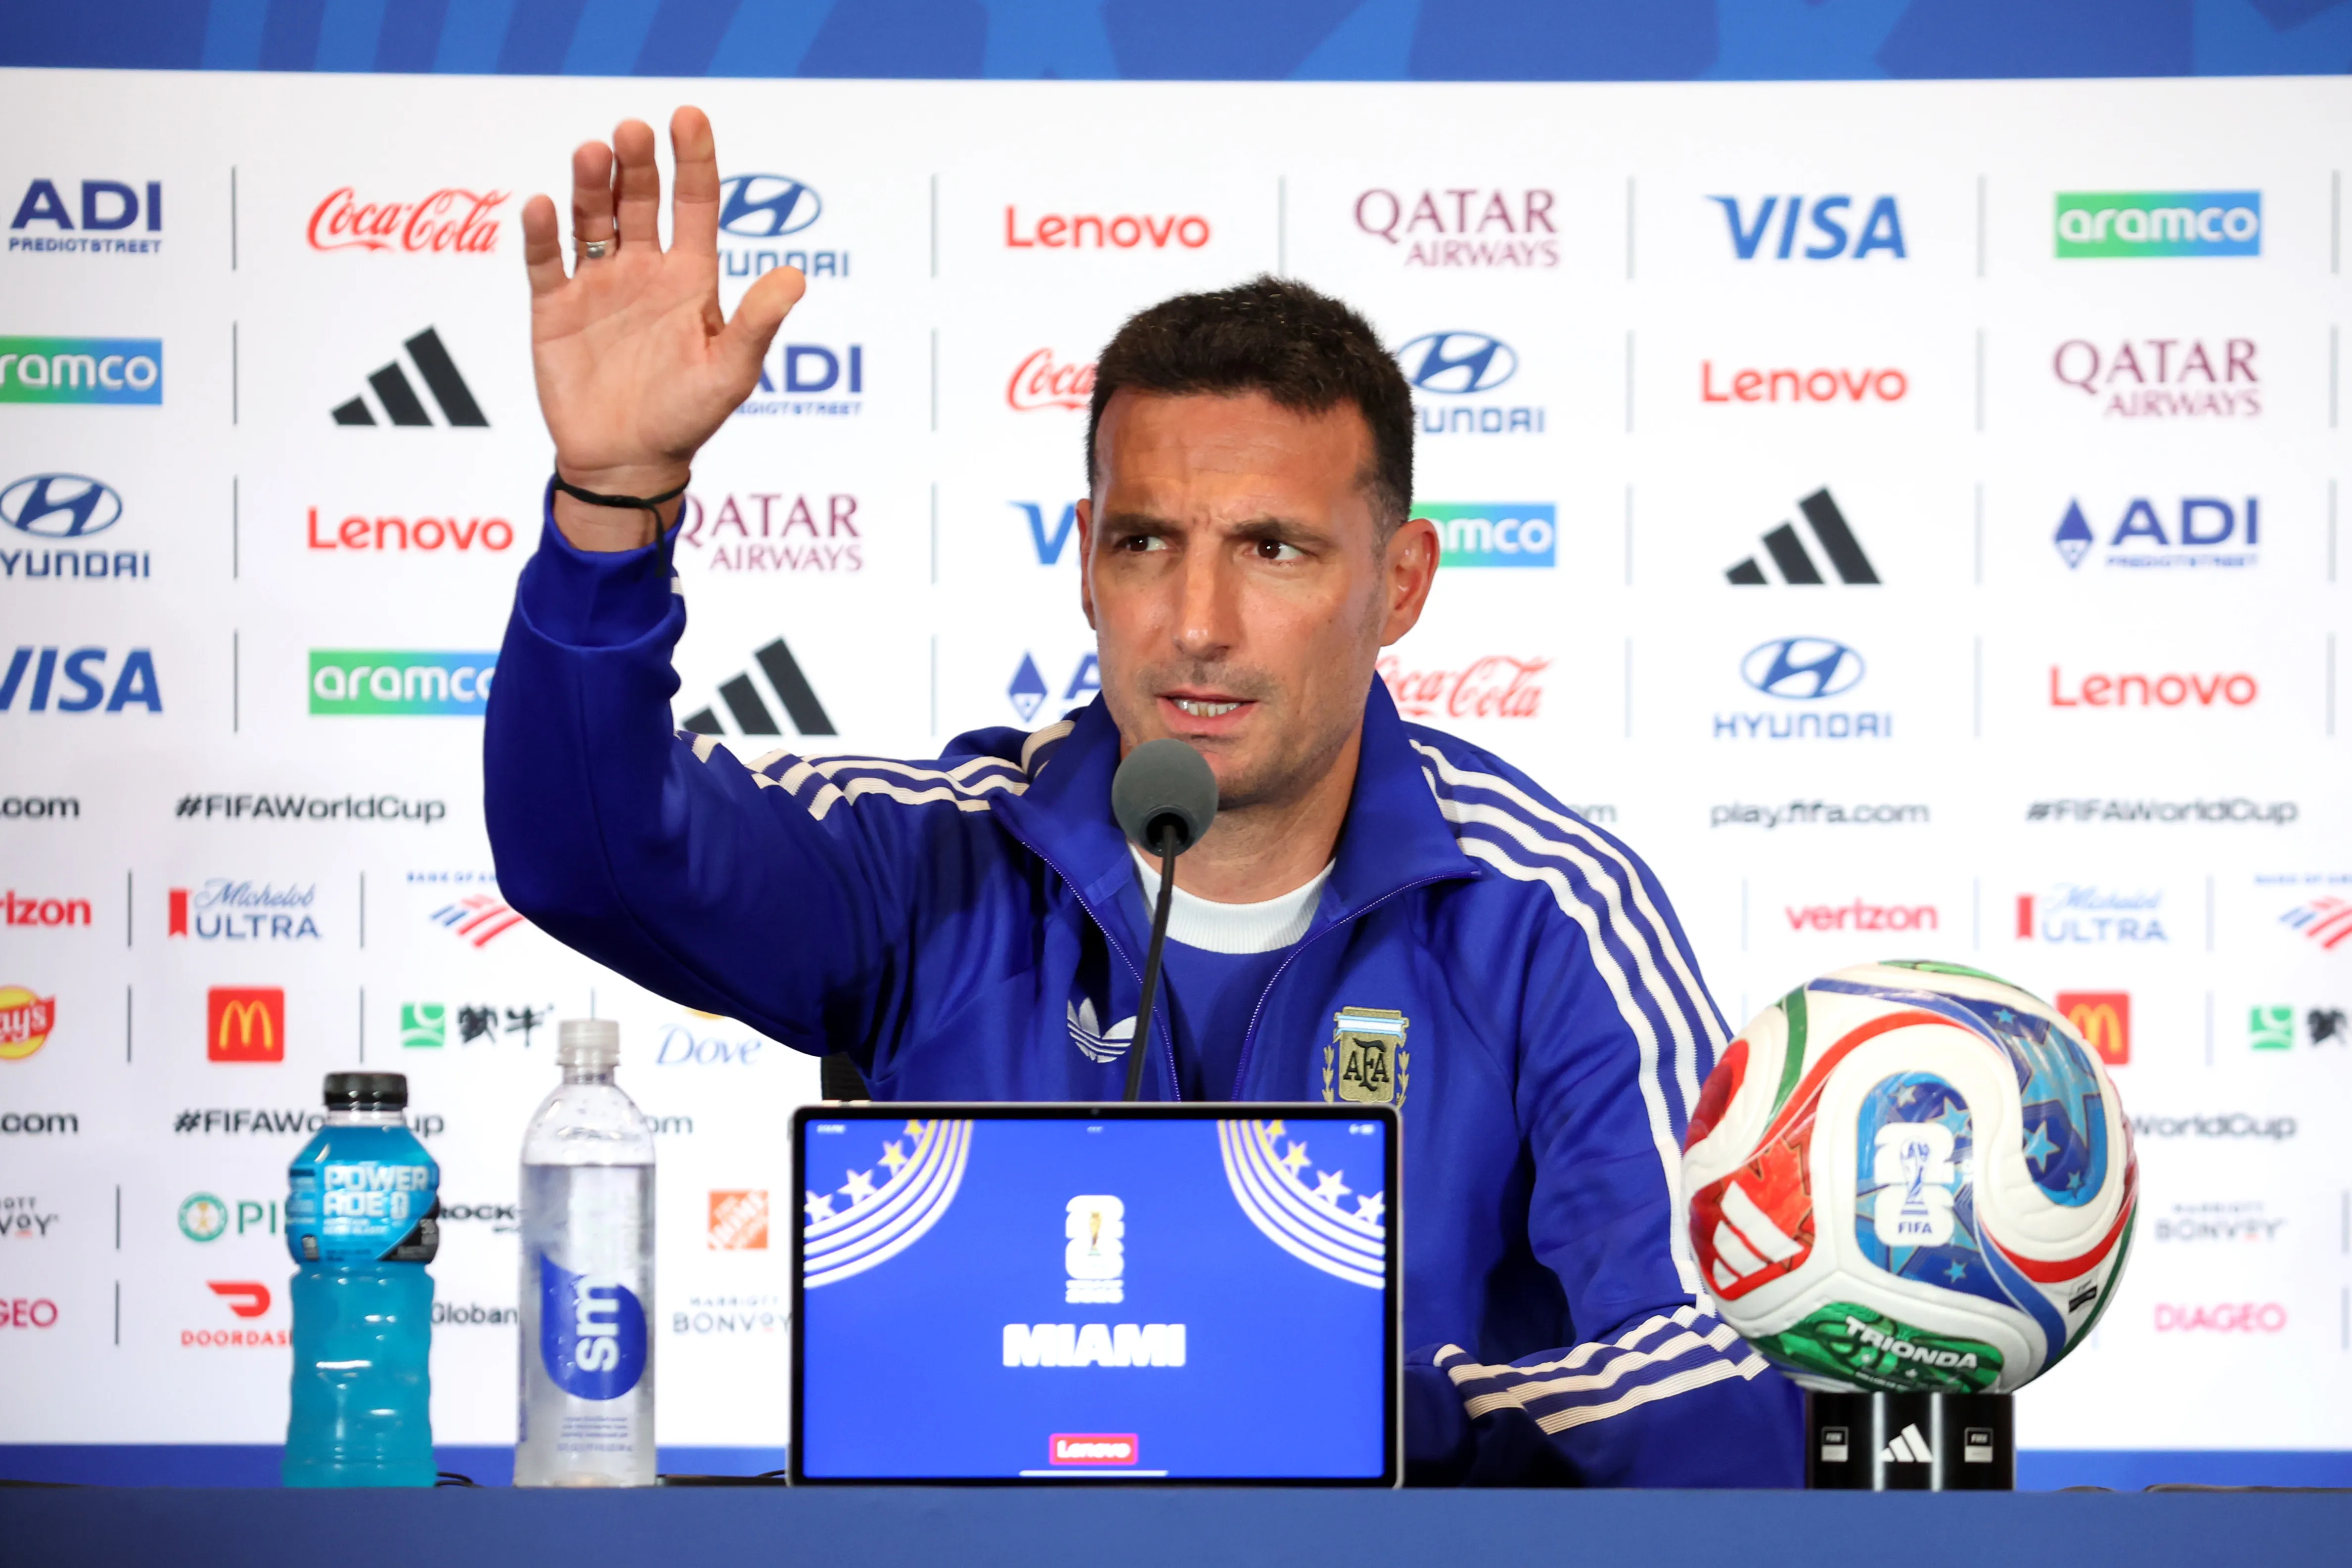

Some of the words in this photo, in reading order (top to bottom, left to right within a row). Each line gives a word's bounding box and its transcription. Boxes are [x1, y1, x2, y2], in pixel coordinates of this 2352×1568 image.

[10, 179, 161, 231] ADI
[307, 187, 511, 253] Coca-Cola
[1354, 189, 1558, 244] QATAR
[1006, 206, 1210, 249] Lenovo
[1704, 195, 1907, 260] VISA
[2059, 207, 2258, 242] aramco
[8, 238, 162, 253] PREDICTSTREET
[1404, 240, 1560, 268] AIRWAYS
[719, 251, 849, 276] UNDAI
[0, 353, 158, 389] ramco
[1702, 361, 1908, 403] Lenovo
[2053, 339, 2259, 394] QATAR
[2108, 389, 2262, 417] AIRWAYS
[1421, 406, 1544, 434] UNDAI
[308, 507, 513, 551] Lenovo
[2109, 496, 2259, 546] ADI
[0, 549, 149, 578] YUNDAI
[710, 544, 862, 571] AIRWAYS
[2050, 666, 2258, 707] Lenovo
[1714, 713, 1891, 739] HYUNDAI
[175, 794, 446, 825] #FIFAWorldCup
[1711, 800, 1929, 829] play.fifa.com
[2026, 798, 2298, 826] #FIFAWorldCup
[196, 878, 316, 909] Michelob
[197, 915, 320, 940] ULTRA
[1786, 898, 1938, 931] verizon
[2043, 917, 2168, 943] ULTRA
[656, 1024, 762, 1066] Dove
[1343, 1037, 1389, 1092] AFA
[324, 1165, 429, 1191] POWER
[323, 1190, 384, 1216] ADE
[1898, 1221, 1932, 1235] FIFA
[2155, 1303, 2287, 1333] DIAGEO
[181, 1330, 292, 1346] DOORDAS
[1003, 1323, 1186, 1367] MIAMI
[1846, 1315, 1977, 1369] TRIONDA
[1056, 1439, 1131, 1460] Lenovo
